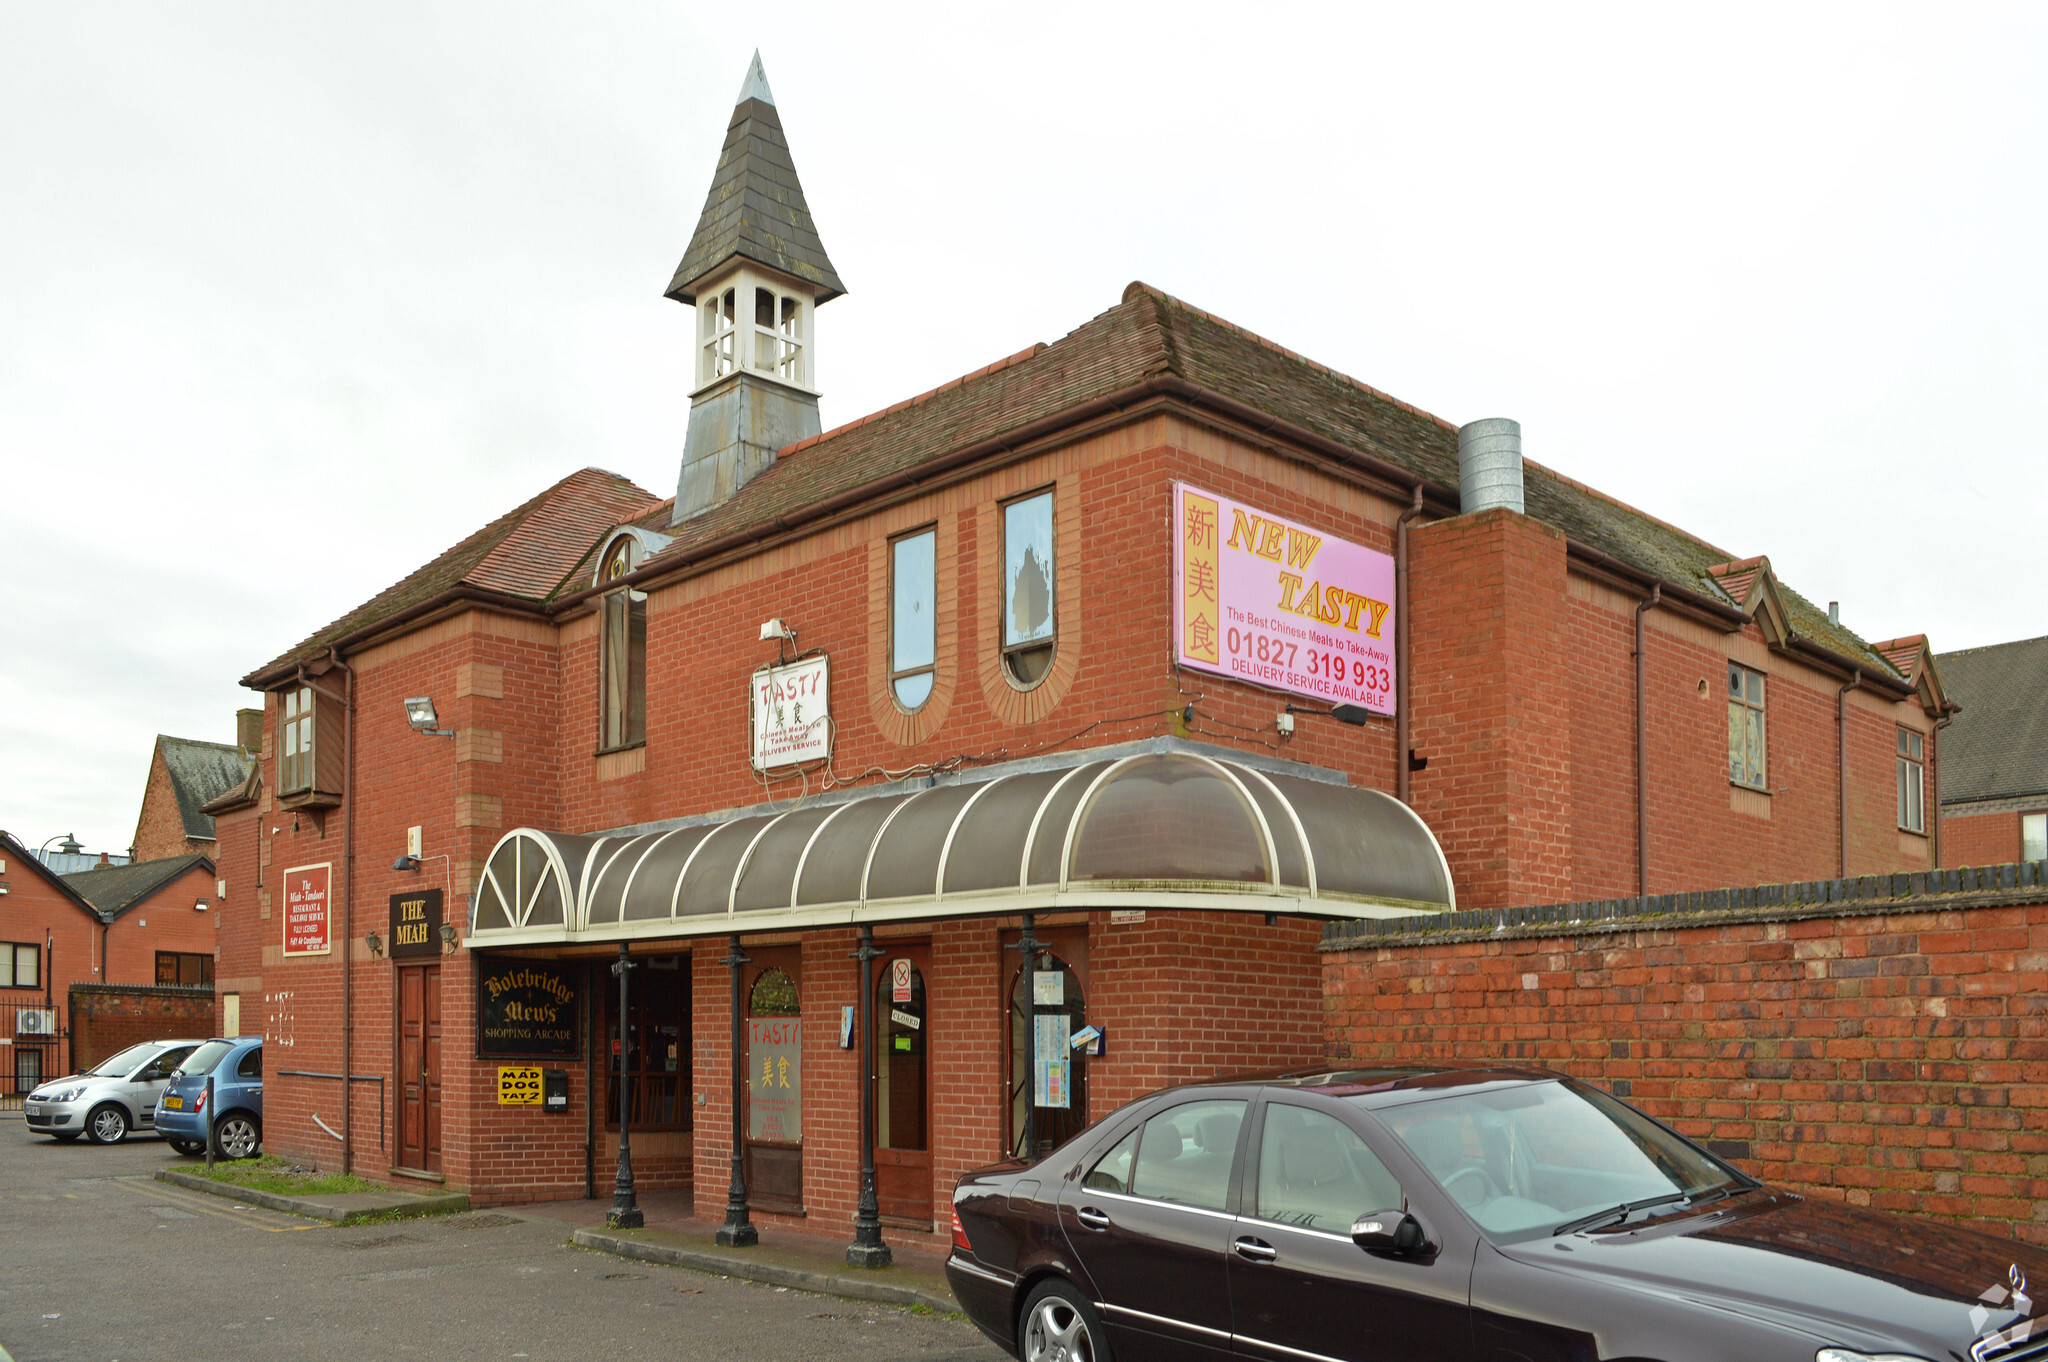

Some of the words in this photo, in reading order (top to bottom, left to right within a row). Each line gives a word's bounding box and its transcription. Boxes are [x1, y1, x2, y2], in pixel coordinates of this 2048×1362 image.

[1226, 507, 1323, 572] NEW
[1187, 503, 1217, 656] 新美食
[1276, 570, 1391, 640] TASTY
[1226, 606, 1245, 623] The
[1247, 613, 1269, 631] Best
[1270, 619, 1307, 640] Chinese
[1308, 630, 1334, 648] Meals
[1335, 636, 1344, 650] to
[1346, 640, 1389, 665] Take-Away
[1227, 627, 1298, 669] 01827
[1306, 649, 1345, 682] 319
[1353, 661, 1390, 694] 933
[761, 670, 821, 706] TASTY
[1231, 658, 1284, 684] DELIVERY
[1286, 672, 1330, 696] SERVICE
[1332, 684, 1385, 708] AVAILABLE
[793, 739, 822, 751] SERVICE
[290, 892, 301, 902] Miah
[306, 890, 324, 901] Tandoori
[302, 880, 311, 890] The
[292, 904, 316, 912] RESTAURANT
[310, 912, 323, 921] SERVICE
[400, 900, 425, 922] THE
[396, 922, 428, 946] MIAH
[484, 967, 574, 1004] Bolebridge
[503, 1000, 559, 1024] Mews
[893, 1012, 918, 1026] CLOSED
[485, 1028, 531, 1039] SHOPPING
[534, 1029, 572, 1040] ARCADE
[752, 1023, 799, 1045] TASTY
[762, 1055, 790, 1088] 美食
[502, 1082, 540, 1090] DOG
[762, 1122, 783, 1130] 01827
